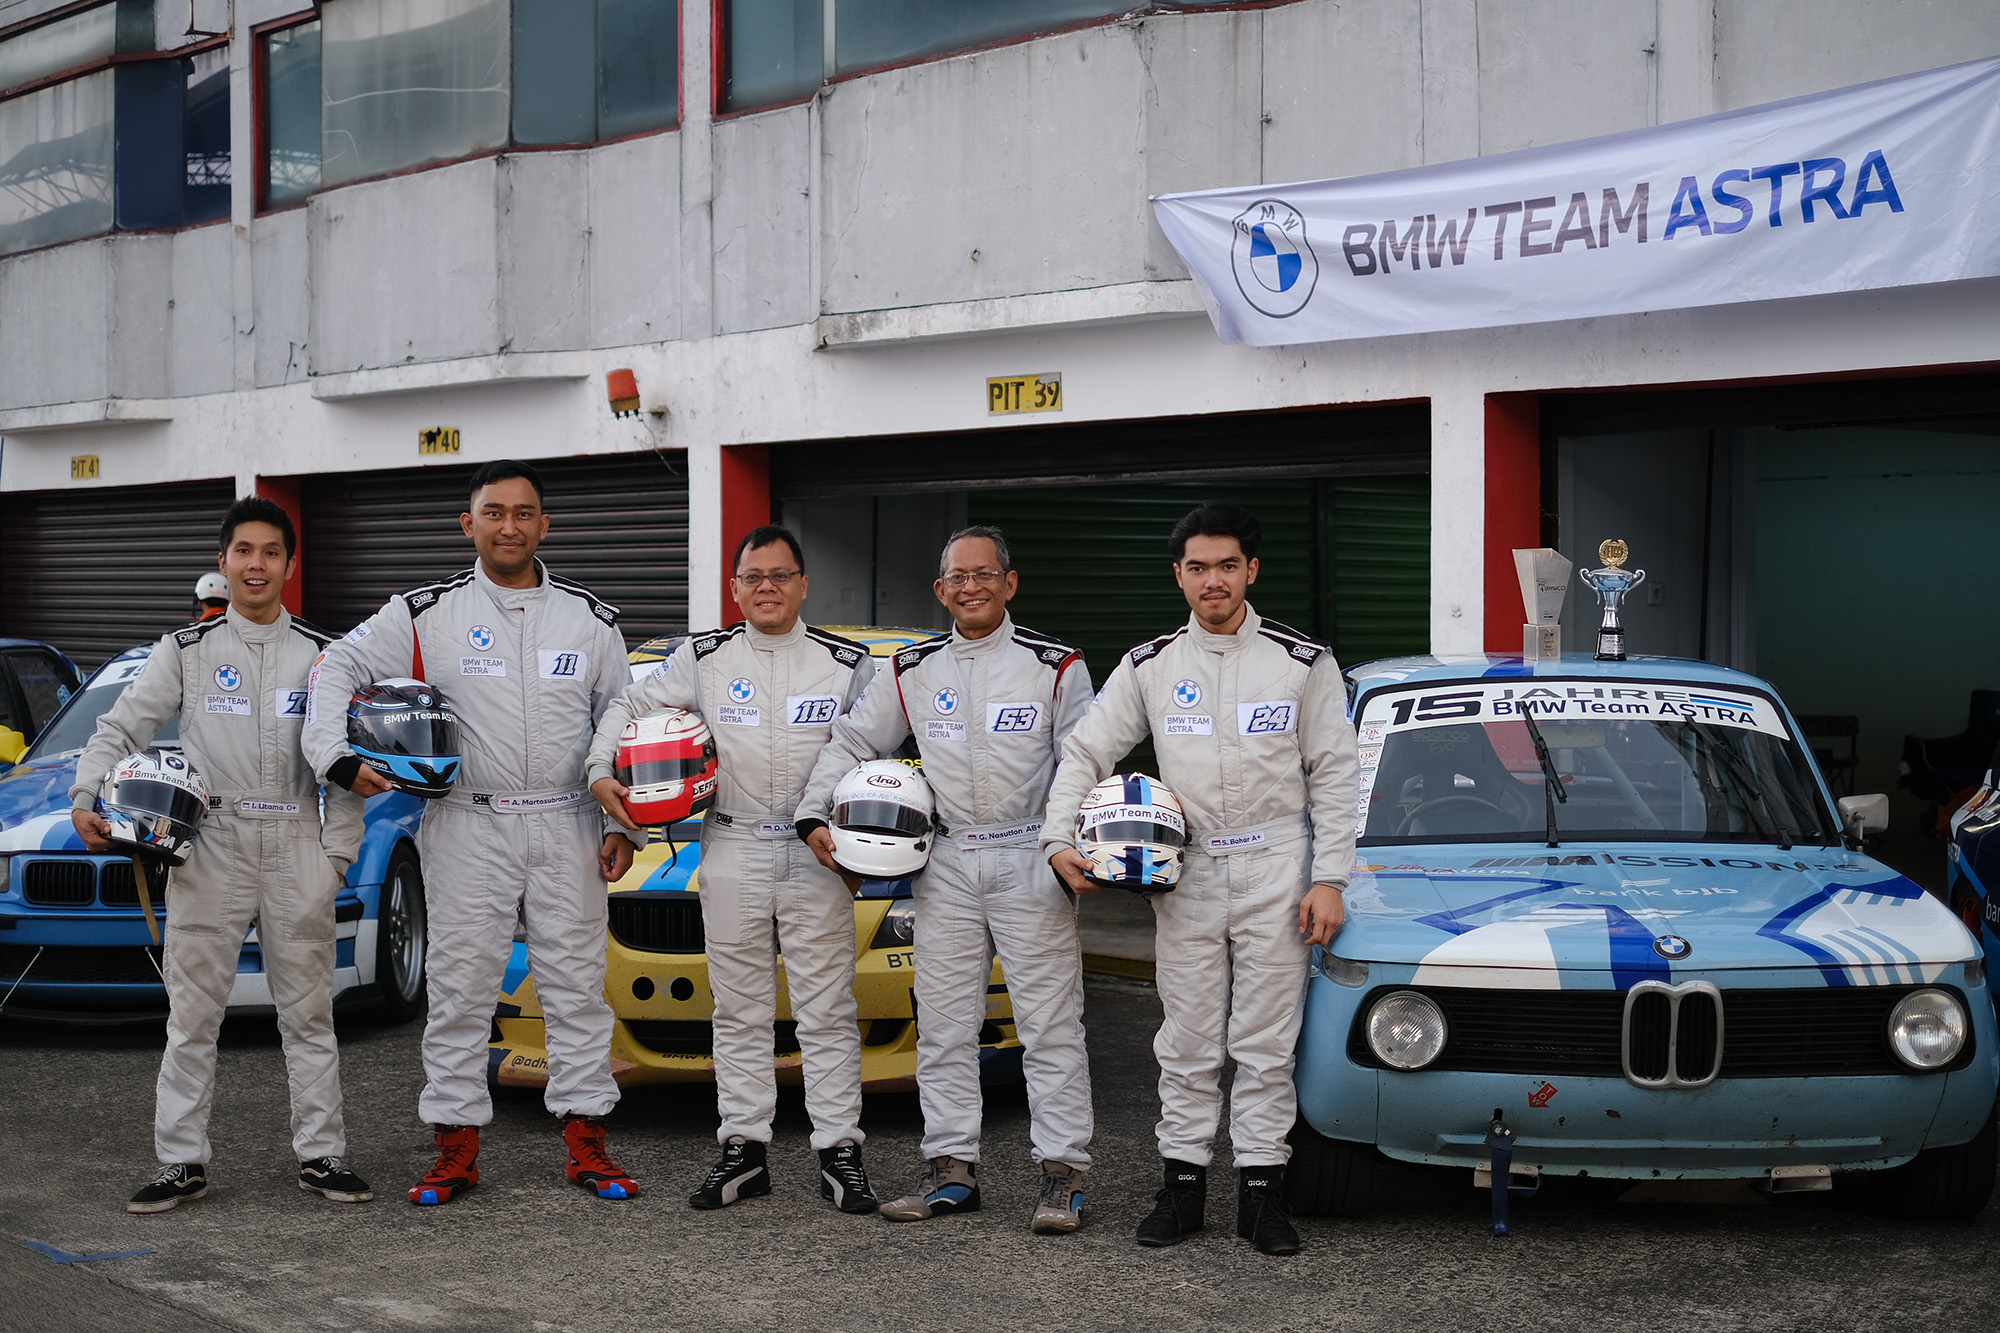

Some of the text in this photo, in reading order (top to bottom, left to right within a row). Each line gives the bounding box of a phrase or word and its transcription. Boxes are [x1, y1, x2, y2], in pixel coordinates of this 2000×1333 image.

[1342, 149, 1905, 277] BMW TEAM ASTRA
[988, 379, 1060, 411] PIT 39
[442, 429, 460, 453] 40
[71, 458, 100, 478] PIT 41
[412, 592, 434, 606] OMP
[594, 604, 614, 621] OMP
[178, 631, 200, 642] OMP
[696, 638, 717, 652] OMP
[1132, 644, 1154, 659] OMP
[1292, 645, 1316, 659] OMP
[836, 649, 858, 662] OMP
[898, 653, 920, 665] OMP
[1042, 651, 1065, 662] OMP
[462, 658, 503, 668] BMW TEAM
[552, 653, 579, 676] 11
[463, 666, 489, 675] ASTRA
[207, 696, 248, 706] BMW TEAM
[1492, 687, 1691, 702] JAHRE
[207, 704, 233, 713] ASTRA
[720, 706, 758, 717] BMW TEAM
[792, 698, 838, 724] 113
[1391, 690, 1485, 726] 15
[1493, 699, 1758, 726] BMW Team ASTRA
[384, 712, 411, 725] BMW
[412, 711, 441, 720] Team
[719, 715, 742, 724] ASTRA
[992, 704, 1038, 732] 53
[1167, 716, 1210, 726] BMW TEAM
[1246, 705, 1291, 733] 24
[928, 721, 964, 731] BMW TEAM
[1167, 725, 1193, 734] ASTRA
[928, 730, 950, 739] ASTRA
[1412, 729, 1470, 741] sparco
[134, 770, 204, 799] Bmw Team Astra
[873, 775, 898, 786] Arai
[209, 798, 222, 807] MP
[472, 794, 489, 804] OM
[715, 813, 733, 825] OMP
[1092, 808, 1182, 829] BMW Team ASTRA
[978, 824, 1042, 841] G. Nasution AB+
[1572, 886, 1739, 898] bank bjb
[511, 1055, 549, 1070] @adh
